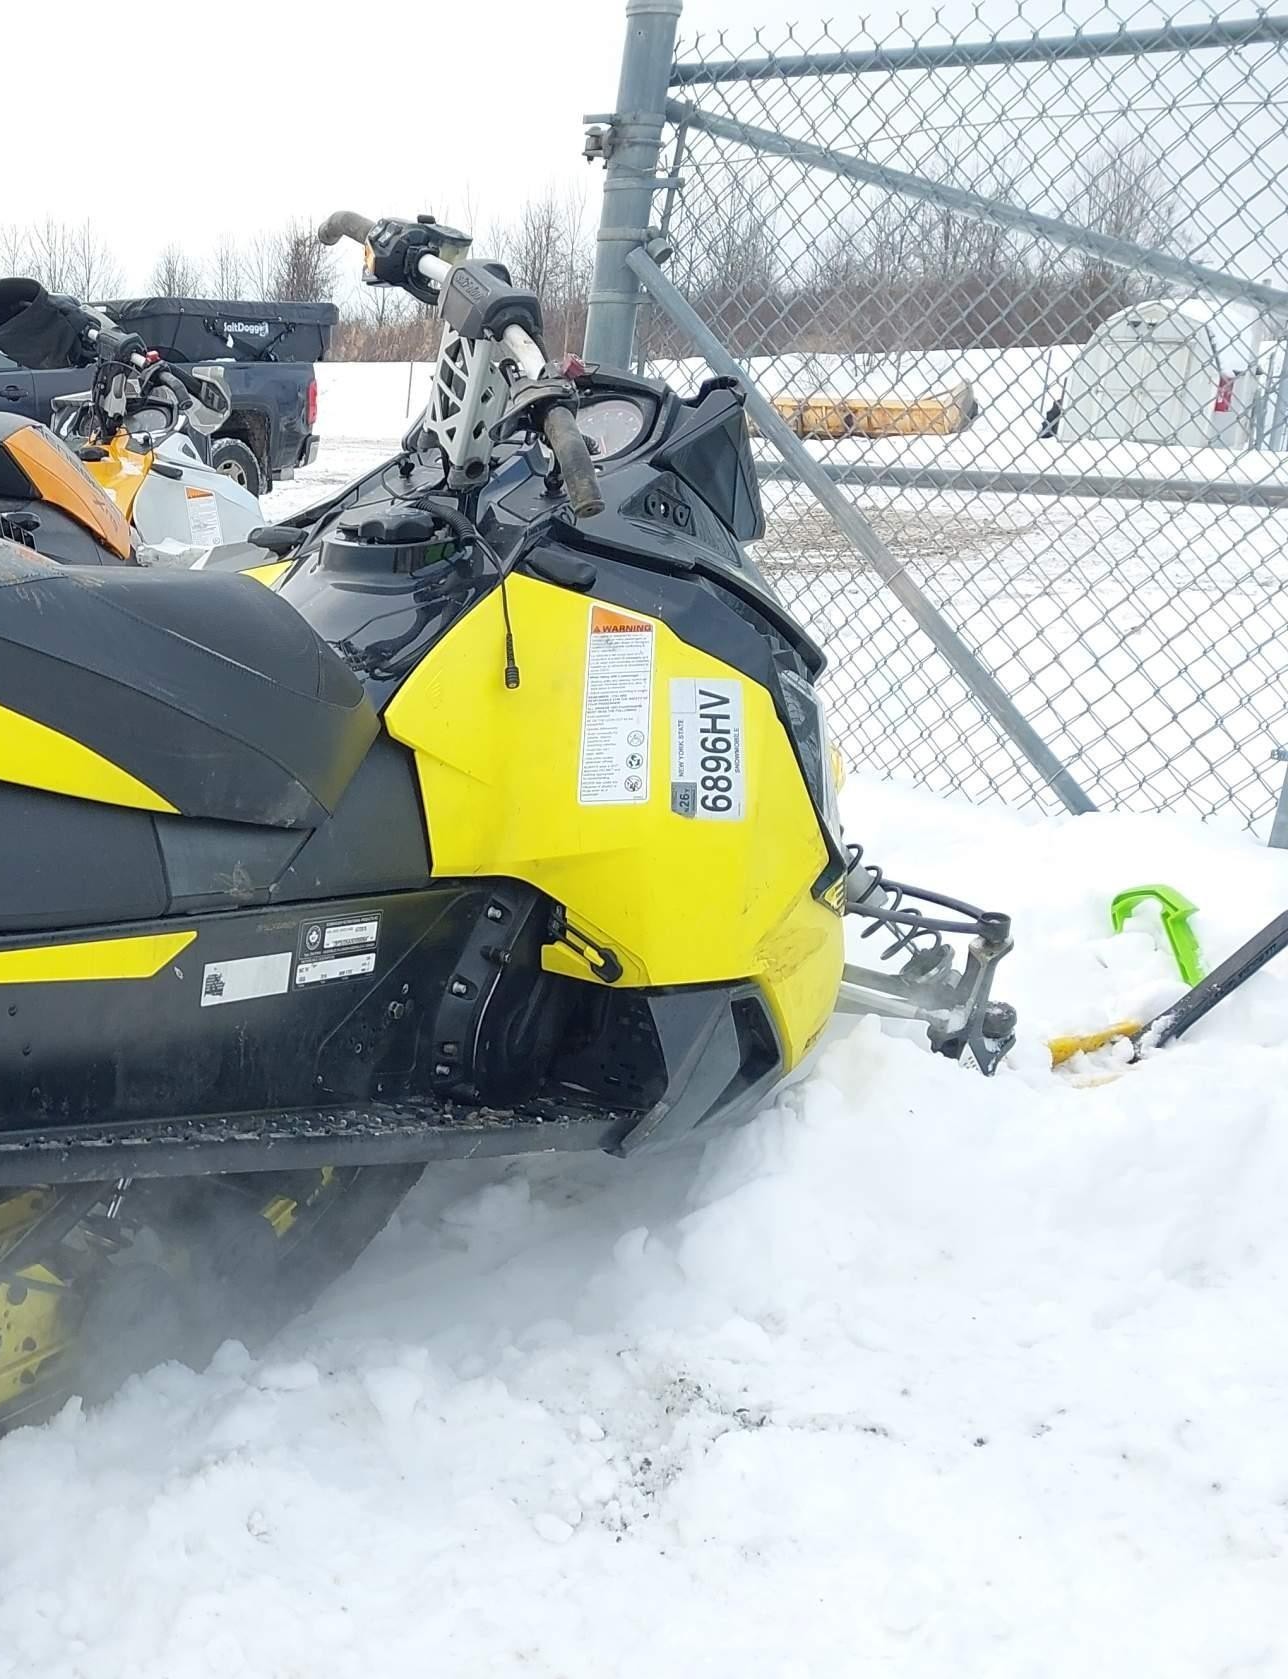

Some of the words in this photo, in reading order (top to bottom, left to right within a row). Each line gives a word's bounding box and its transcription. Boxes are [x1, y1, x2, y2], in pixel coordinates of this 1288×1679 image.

[602, 624, 652, 633] WARNING
[699, 689, 732, 812] 6896HV
[679, 793, 690, 808] 26
